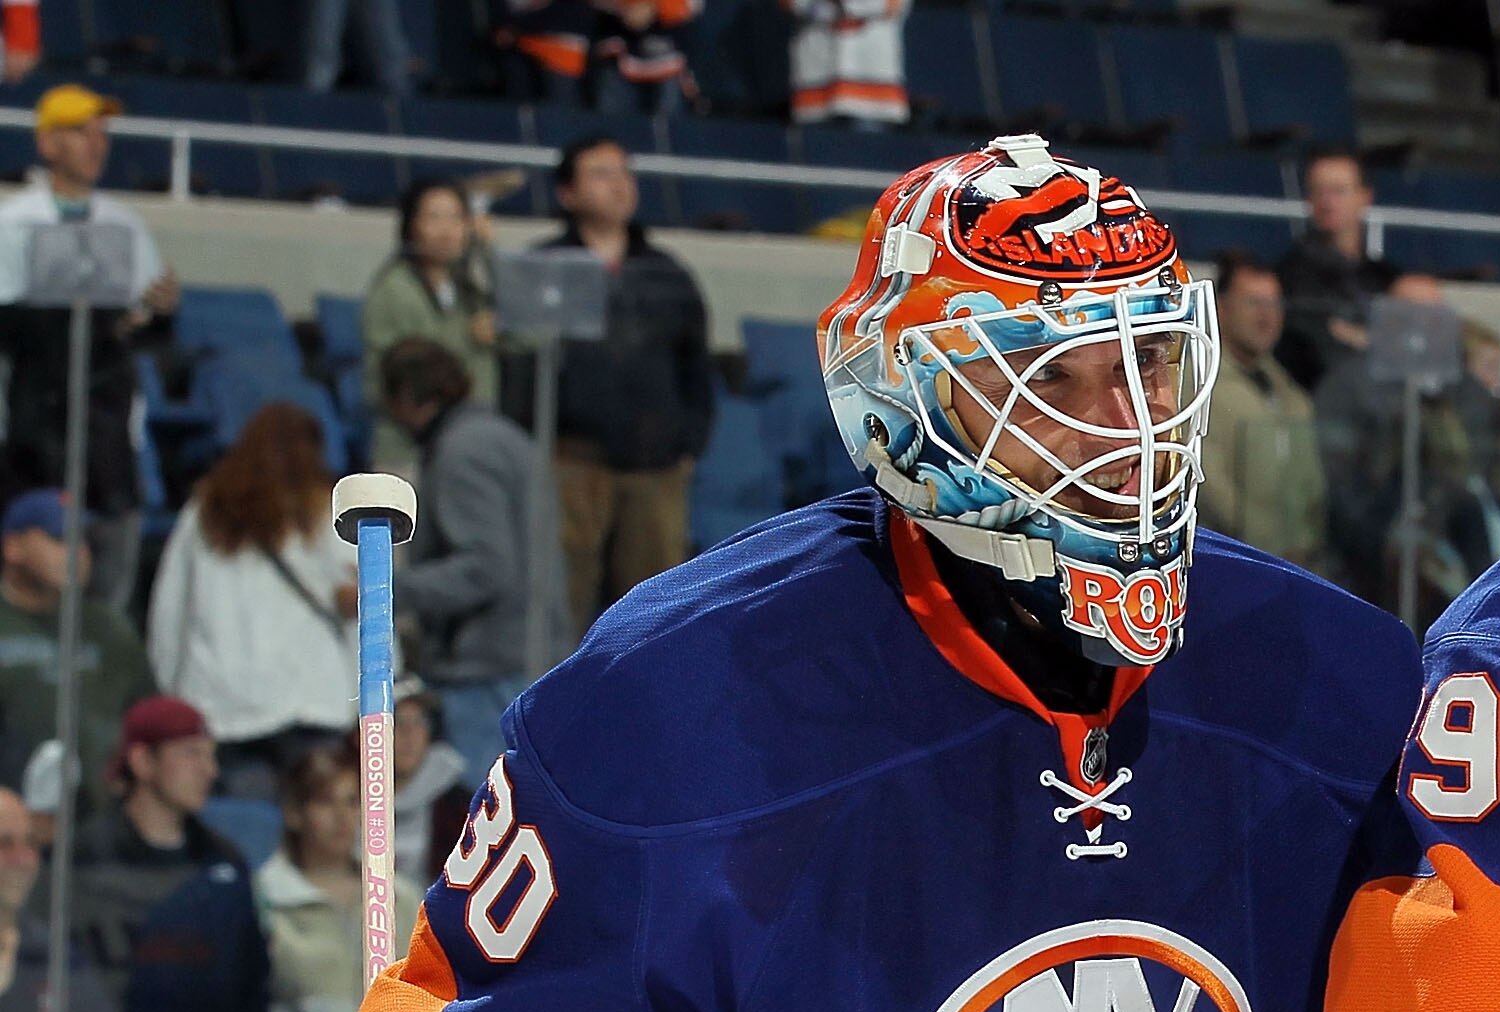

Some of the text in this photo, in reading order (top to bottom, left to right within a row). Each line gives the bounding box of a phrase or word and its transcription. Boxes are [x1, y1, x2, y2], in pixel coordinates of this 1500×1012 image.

[366, 721, 386, 849] ROLOSON #30
[444, 753, 560, 964] 30
